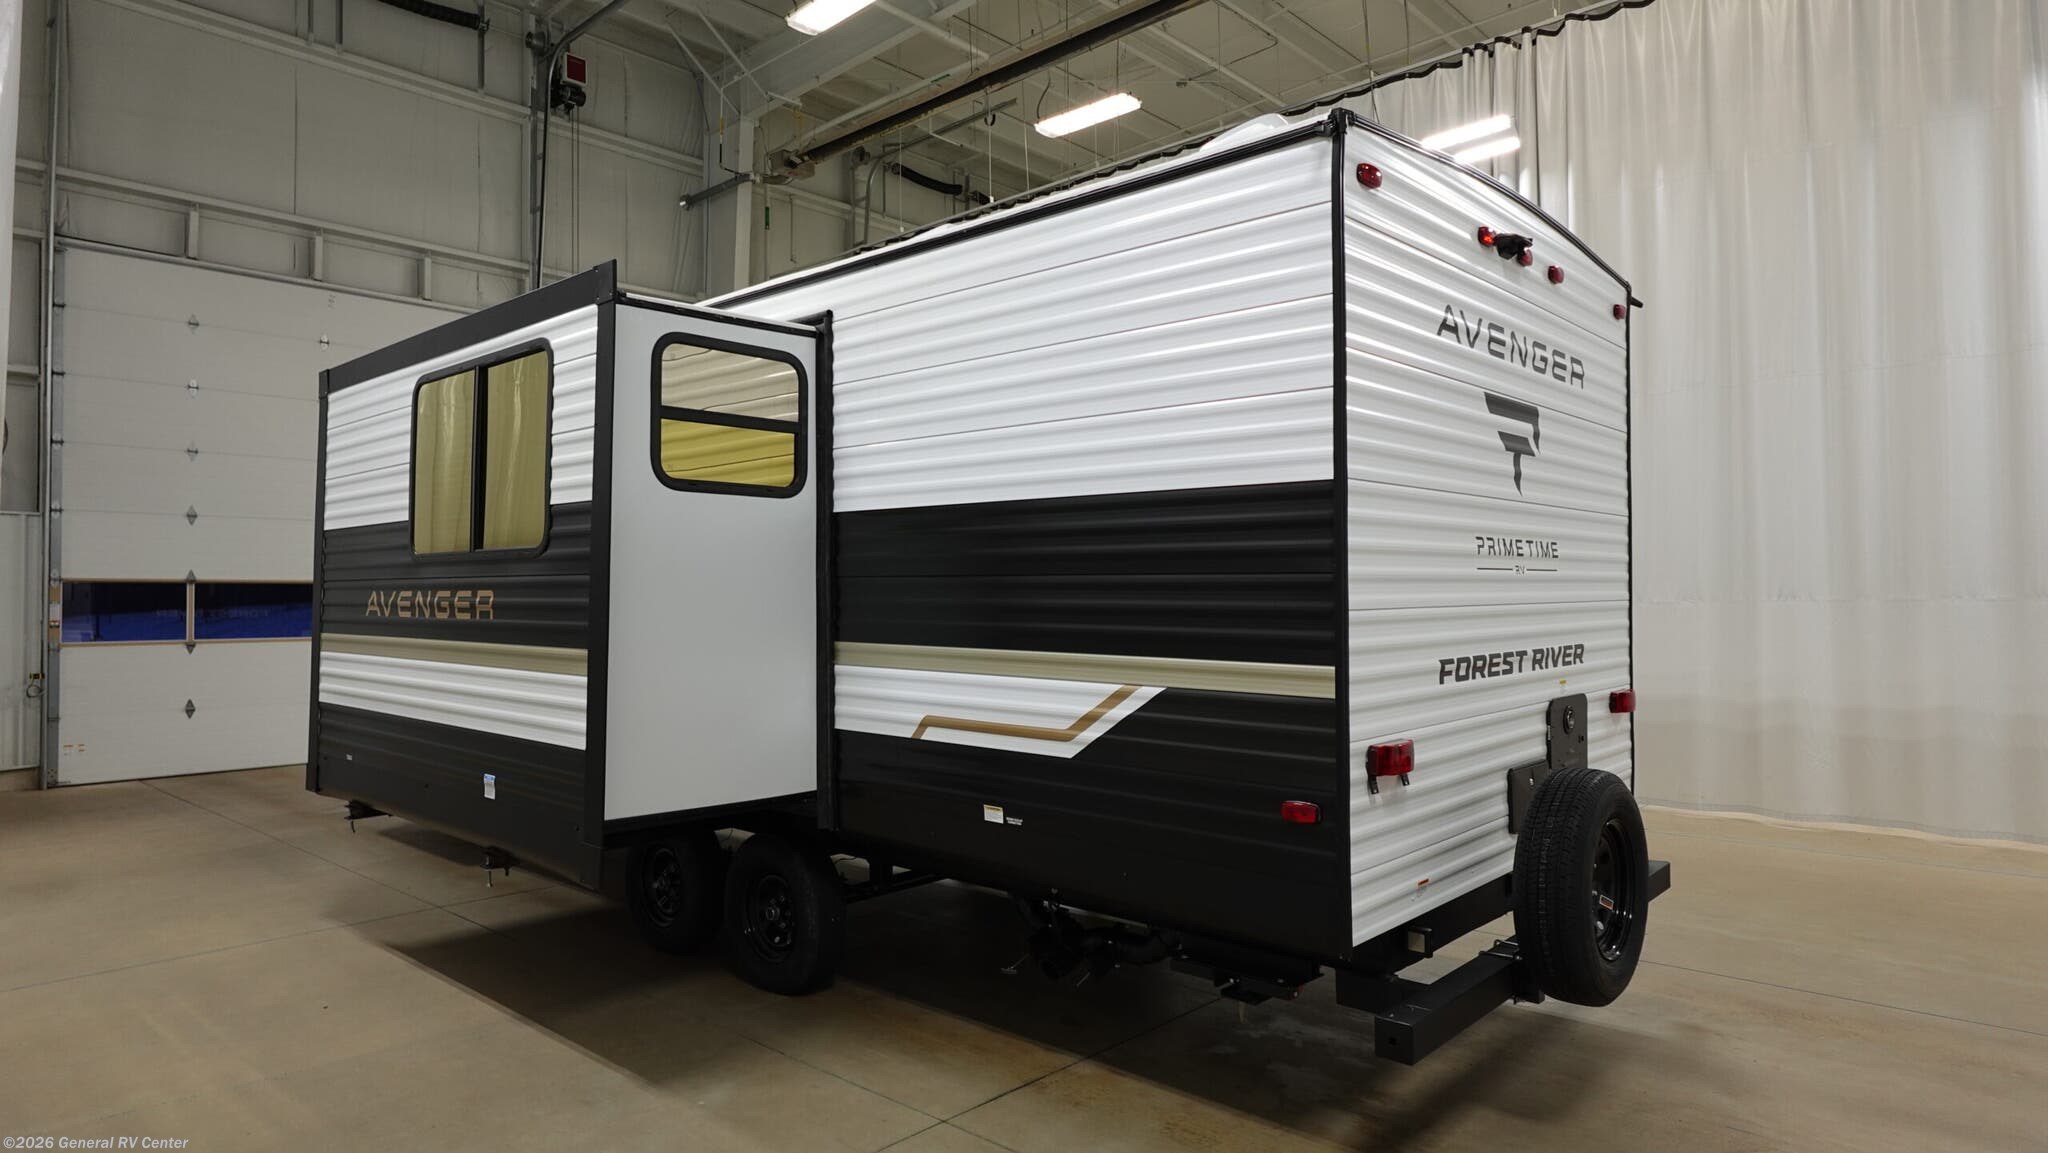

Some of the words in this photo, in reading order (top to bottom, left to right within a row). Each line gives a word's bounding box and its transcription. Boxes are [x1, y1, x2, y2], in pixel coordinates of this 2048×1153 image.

[1437, 304, 1585, 389] AVENGER
[365, 589, 494, 620] AVENGER
[1438, 650, 1528, 685] FOREST
[1531, 643, 1585, 672] RIVER
